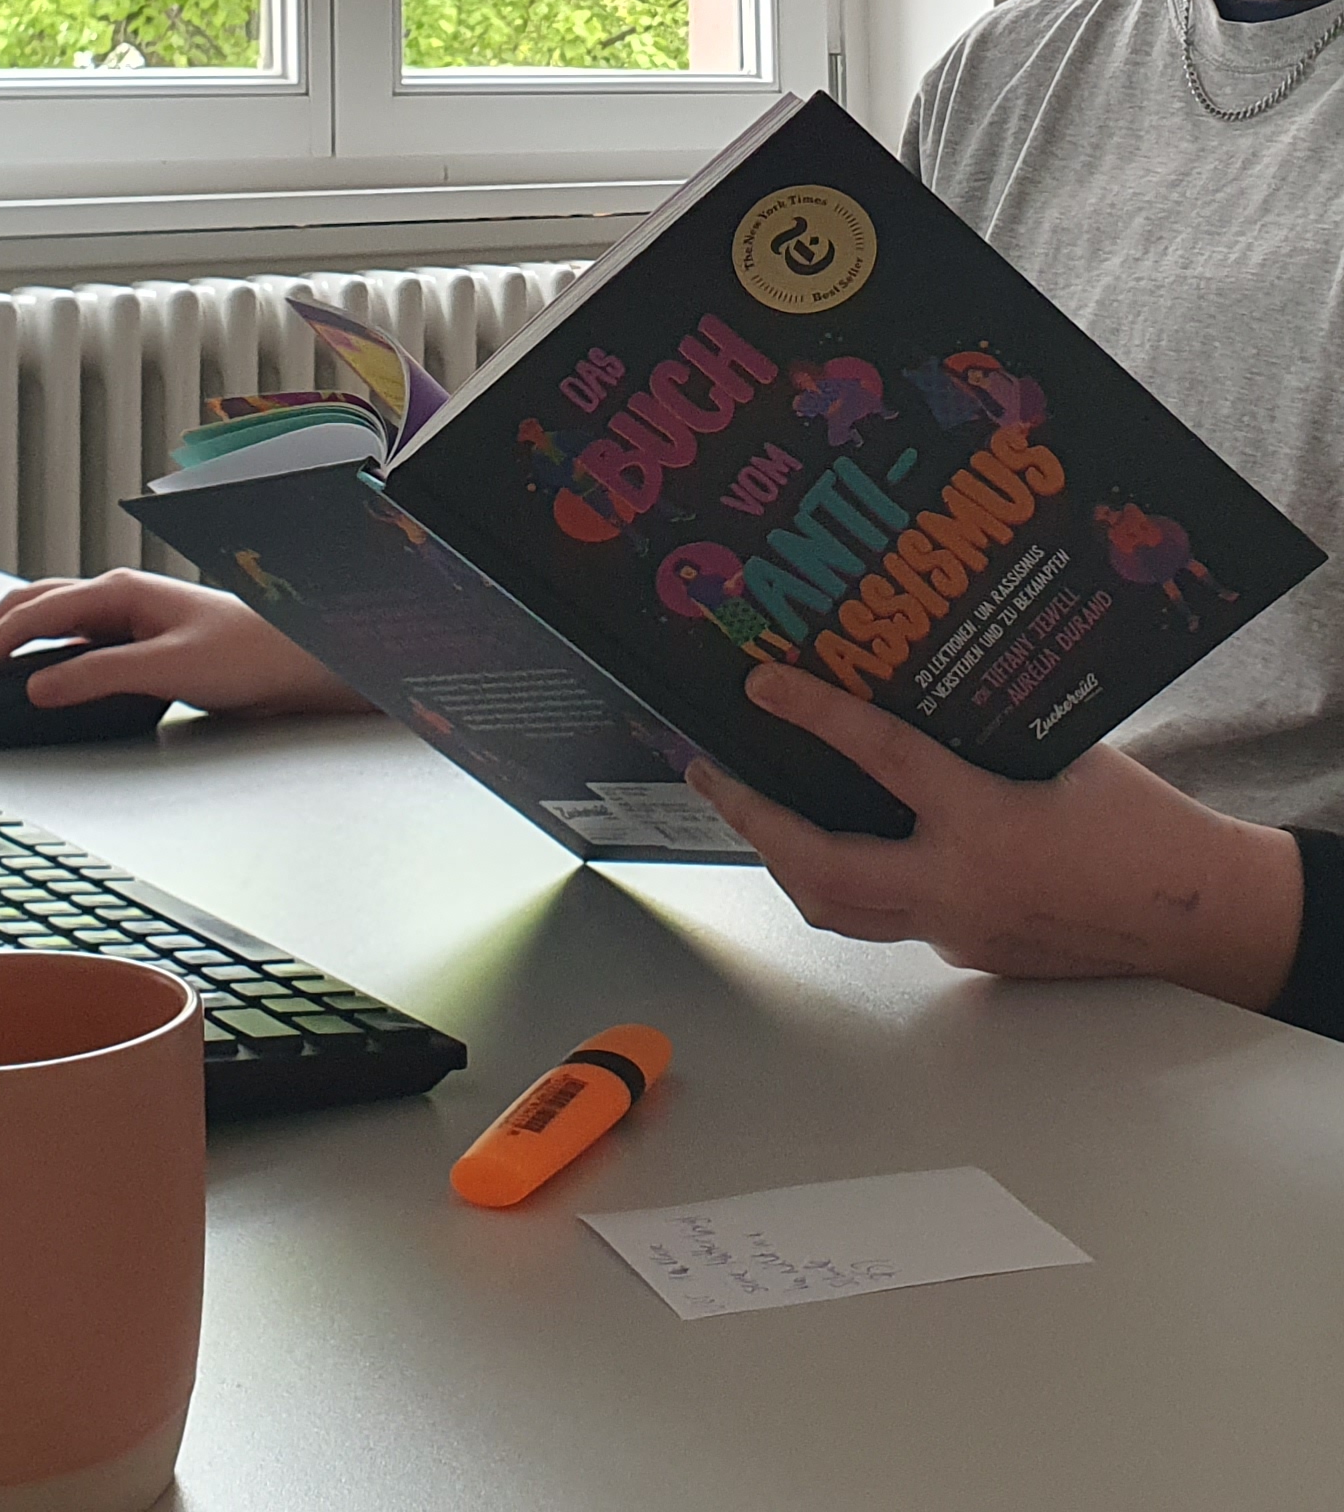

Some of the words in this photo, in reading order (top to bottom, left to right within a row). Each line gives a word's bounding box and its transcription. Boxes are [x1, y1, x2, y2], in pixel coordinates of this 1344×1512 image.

[743, 246, 754, 271] The
[758, 200, 786, 220] York
[788, 194, 828, 206] Times
[811, 285, 840, 303] Best
[838, 256, 864, 289] Seller
[559, 347, 626, 413] DAS
[577, 313, 779, 514] BUCH
[720, 442, 803, 516] VOM
[743, 447, 918, 643] ANTI-
[814, 426, 1066, 702] ASSISMUS
[914, 669, 933, 689] 20
[974, 601, 997, 621] UM
[990, 544, 1045, 604] RASSISMUS
[1055, 590, 1113, 651] DURAND
[917, 696, 938, 716] ZU
[931, 644, 985, 699] VERSTEHEN
[979, 623, 1004, 648] UND
[997, 606, 1018, 626] ZU
[1028, 672, 1099, 740] Zuckersüß
